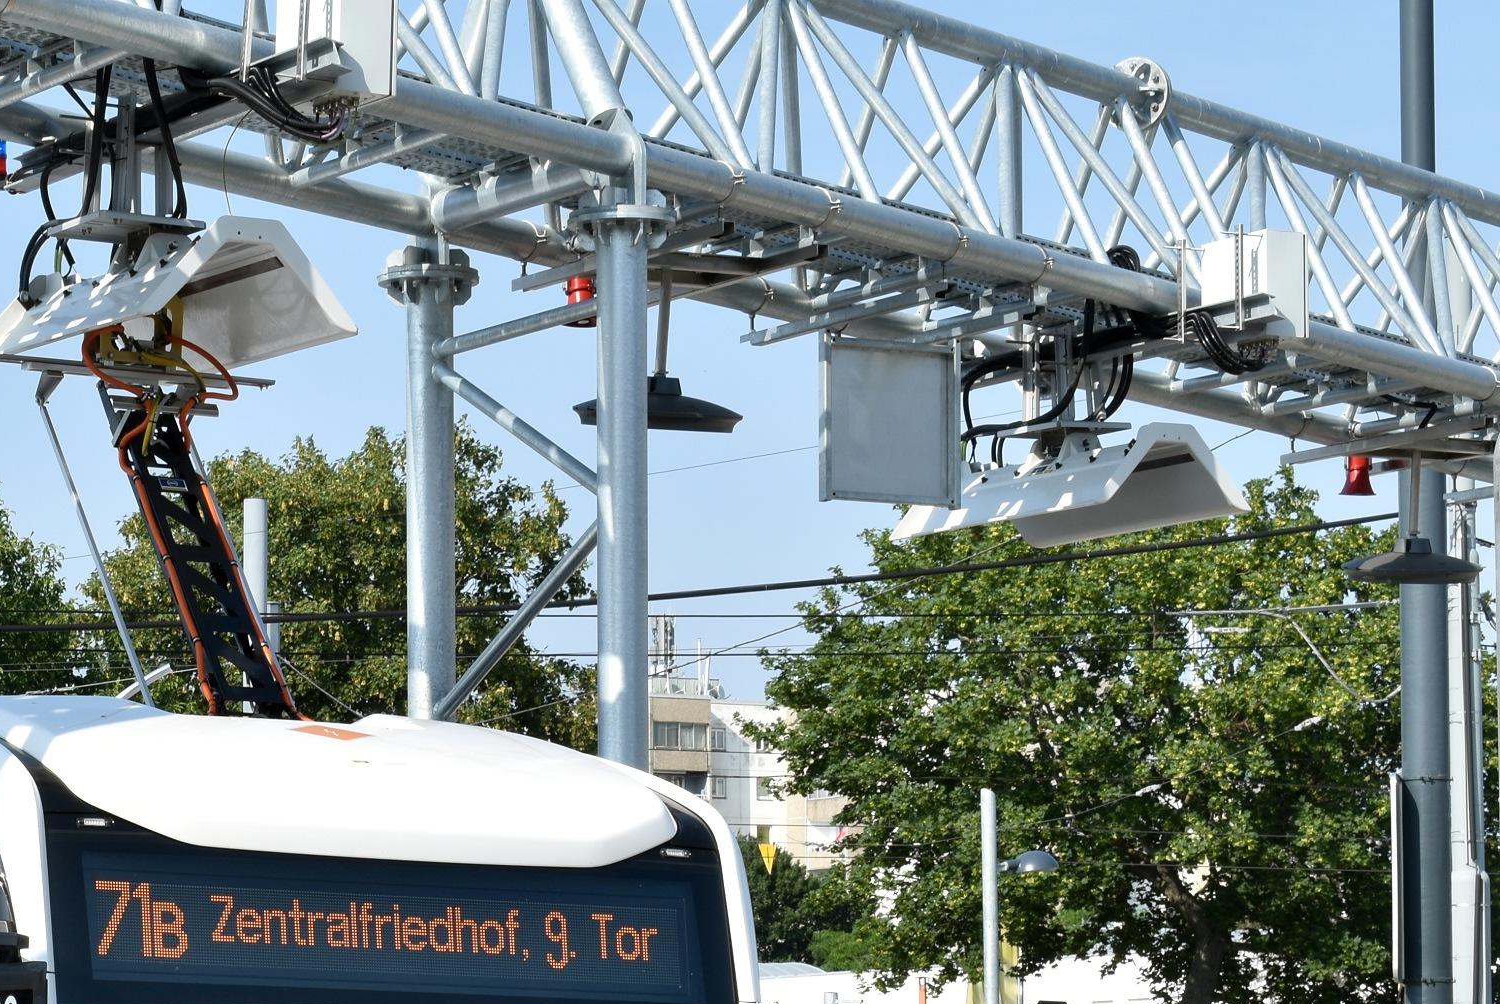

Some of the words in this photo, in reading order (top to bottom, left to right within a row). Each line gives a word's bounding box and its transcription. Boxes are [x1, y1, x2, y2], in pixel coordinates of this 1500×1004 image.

[95, 880, 188, 958] 71B
[210, 895, 529, 962] Zentralfriedhof,
[544, 911, 576, 969] 9.
[591, 913, 658, 961] Tor
